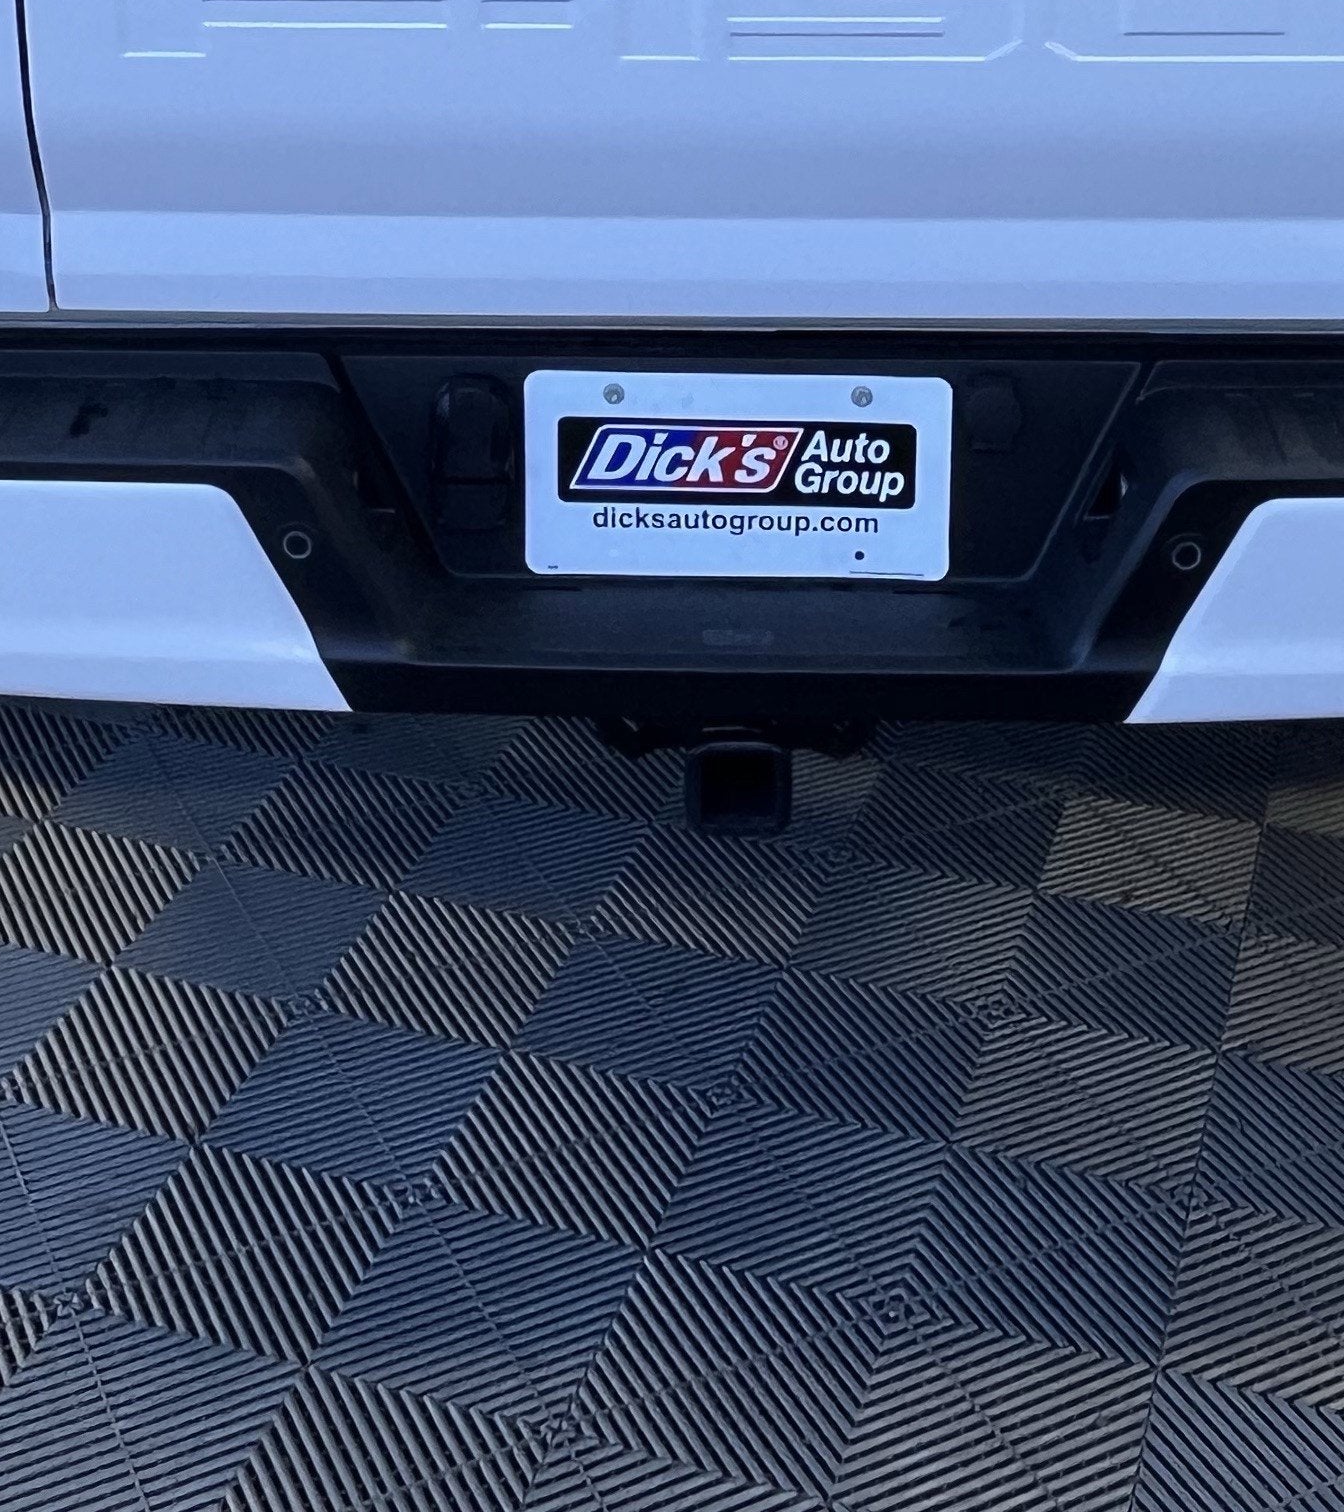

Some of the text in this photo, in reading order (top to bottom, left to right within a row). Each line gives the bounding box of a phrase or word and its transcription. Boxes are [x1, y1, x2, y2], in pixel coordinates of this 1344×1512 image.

[800, 429, 891, 464] Auto
[793, 461, 906, 503] Group
[592, 506, 880, 536] dicksautogroup.com
